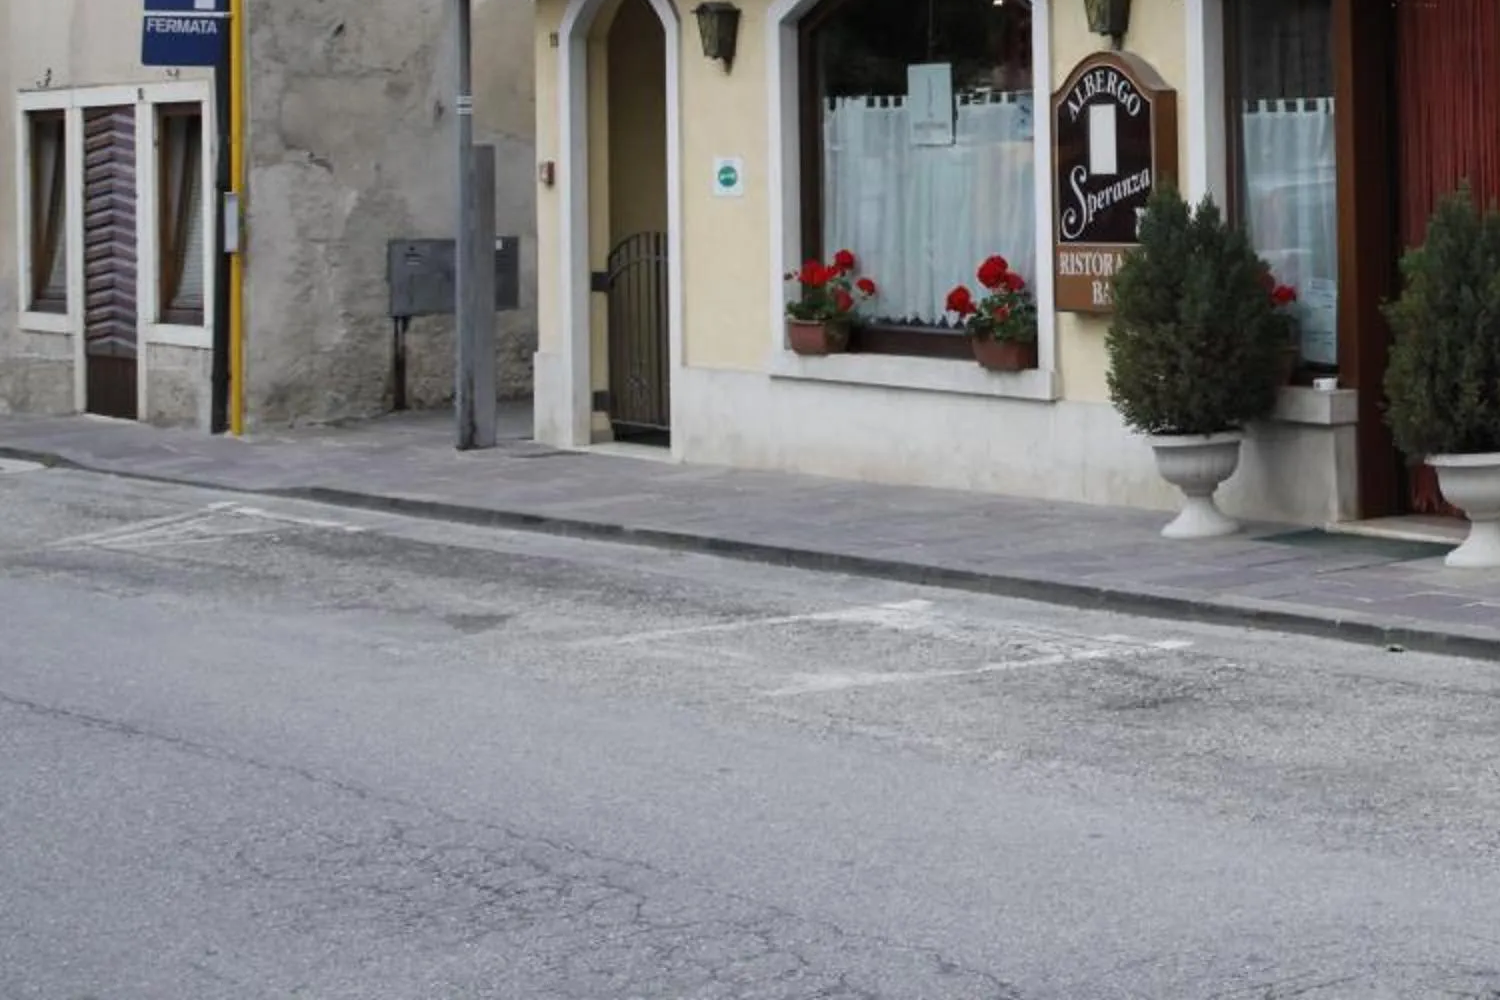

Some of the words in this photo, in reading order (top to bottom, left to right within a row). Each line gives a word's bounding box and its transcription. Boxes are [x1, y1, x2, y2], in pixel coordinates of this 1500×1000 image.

[146, 17, 218, 35] FERMATA
[1067, 69, 1141, 121] ALBERGO
[1062, 165, 1151, 239] Speranza
[1060, 251, 1147, 276] RISTORA
[1092, 280, 1113, 305] BA
